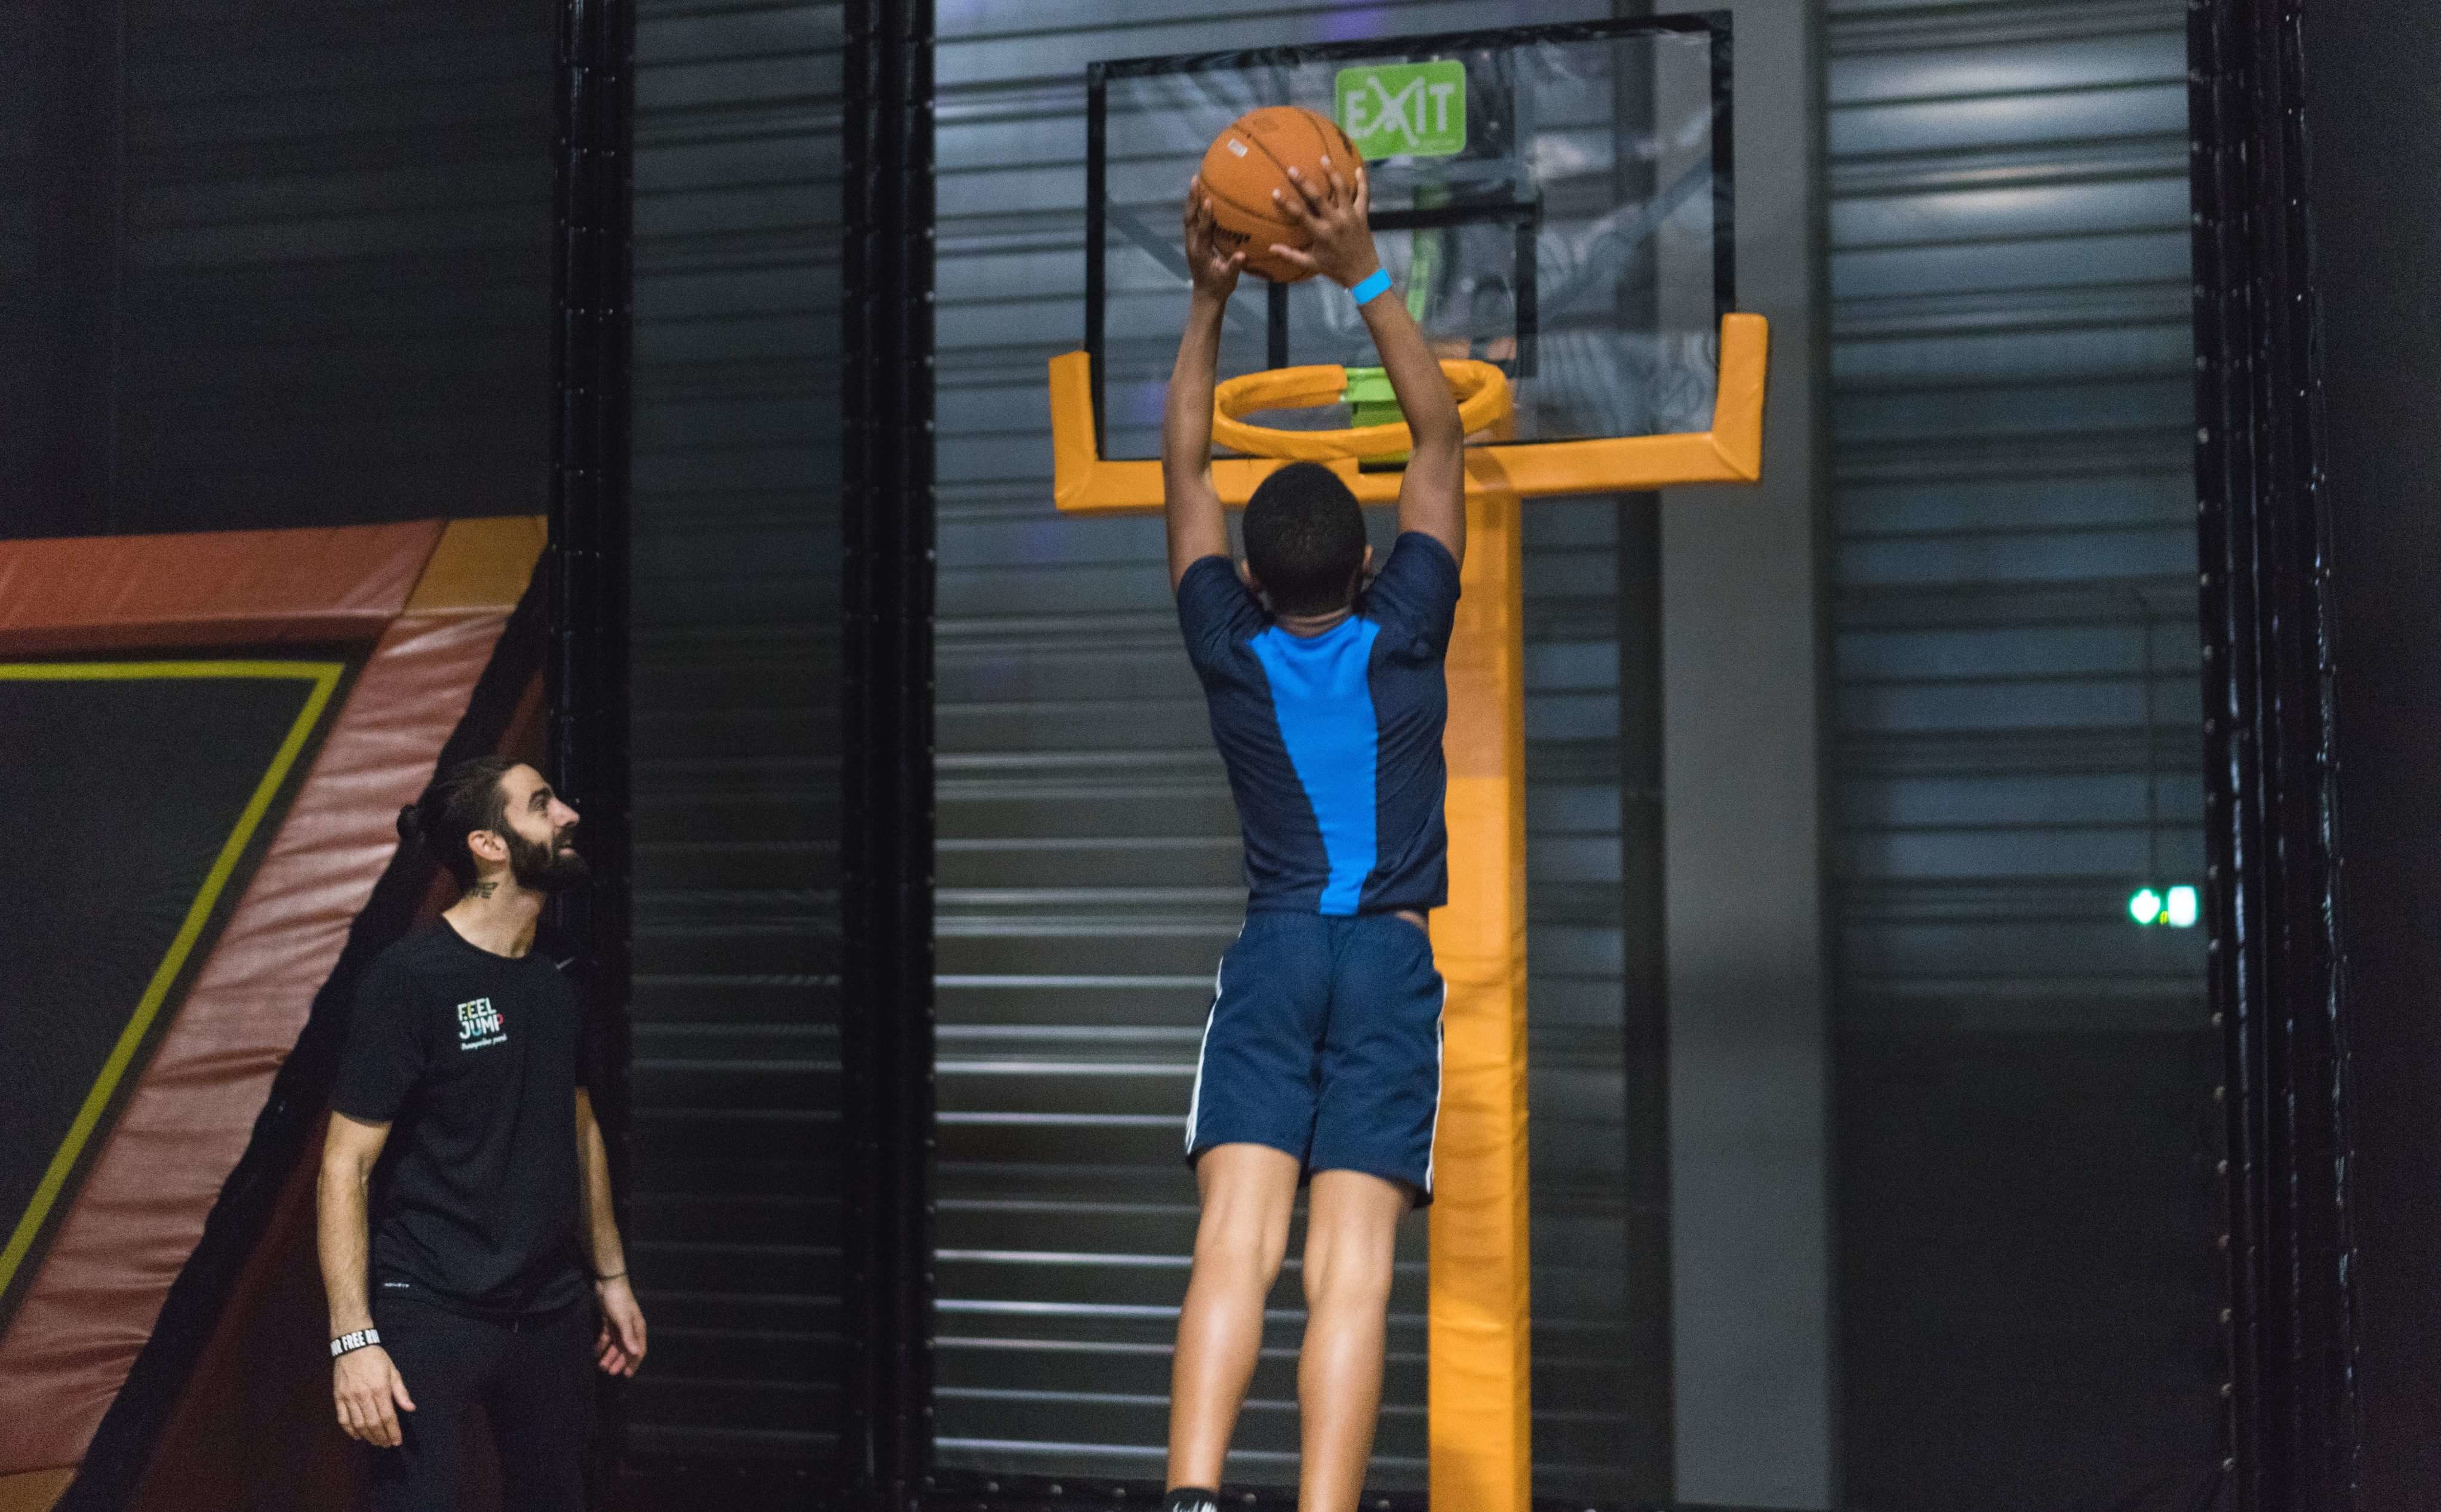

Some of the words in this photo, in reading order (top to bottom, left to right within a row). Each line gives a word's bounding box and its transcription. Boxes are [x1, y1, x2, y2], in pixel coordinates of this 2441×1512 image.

[1345, 76, 1455, 147] EXIT
[458, 997, 497, 1021] FEEL
[460, 1014, 504, 1039] JUMP
[342, 1331, 365, 1351] FREE
